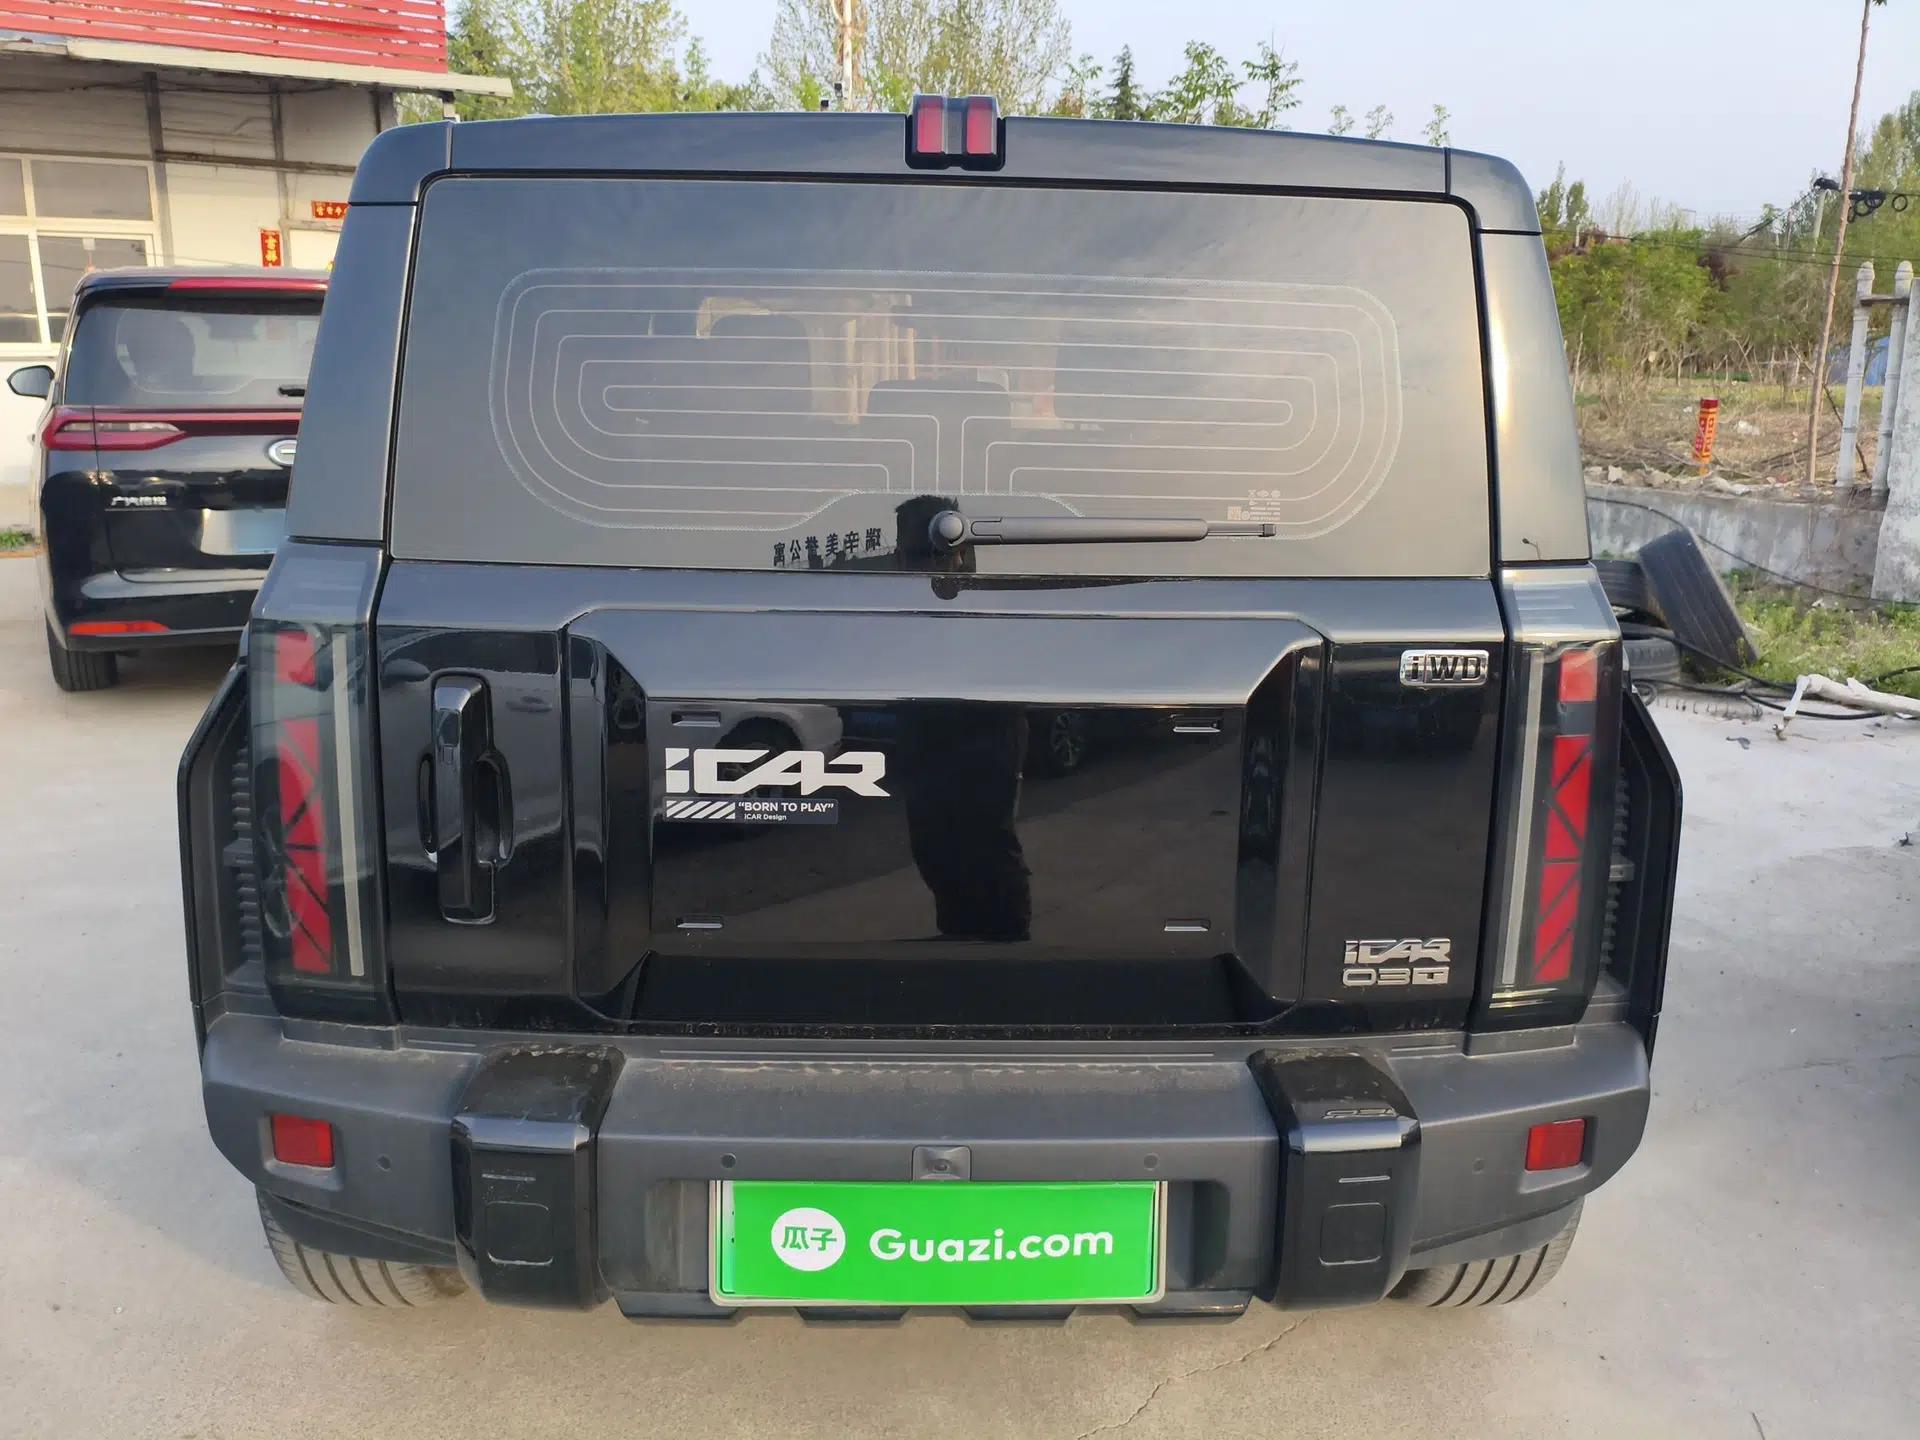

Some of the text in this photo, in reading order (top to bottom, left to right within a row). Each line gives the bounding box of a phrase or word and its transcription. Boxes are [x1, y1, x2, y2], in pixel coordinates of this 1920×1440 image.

[665, 747, 891, 797] iCAR
[781, 802, 798, 812] TO
[763, 813, 787, 821] Design
